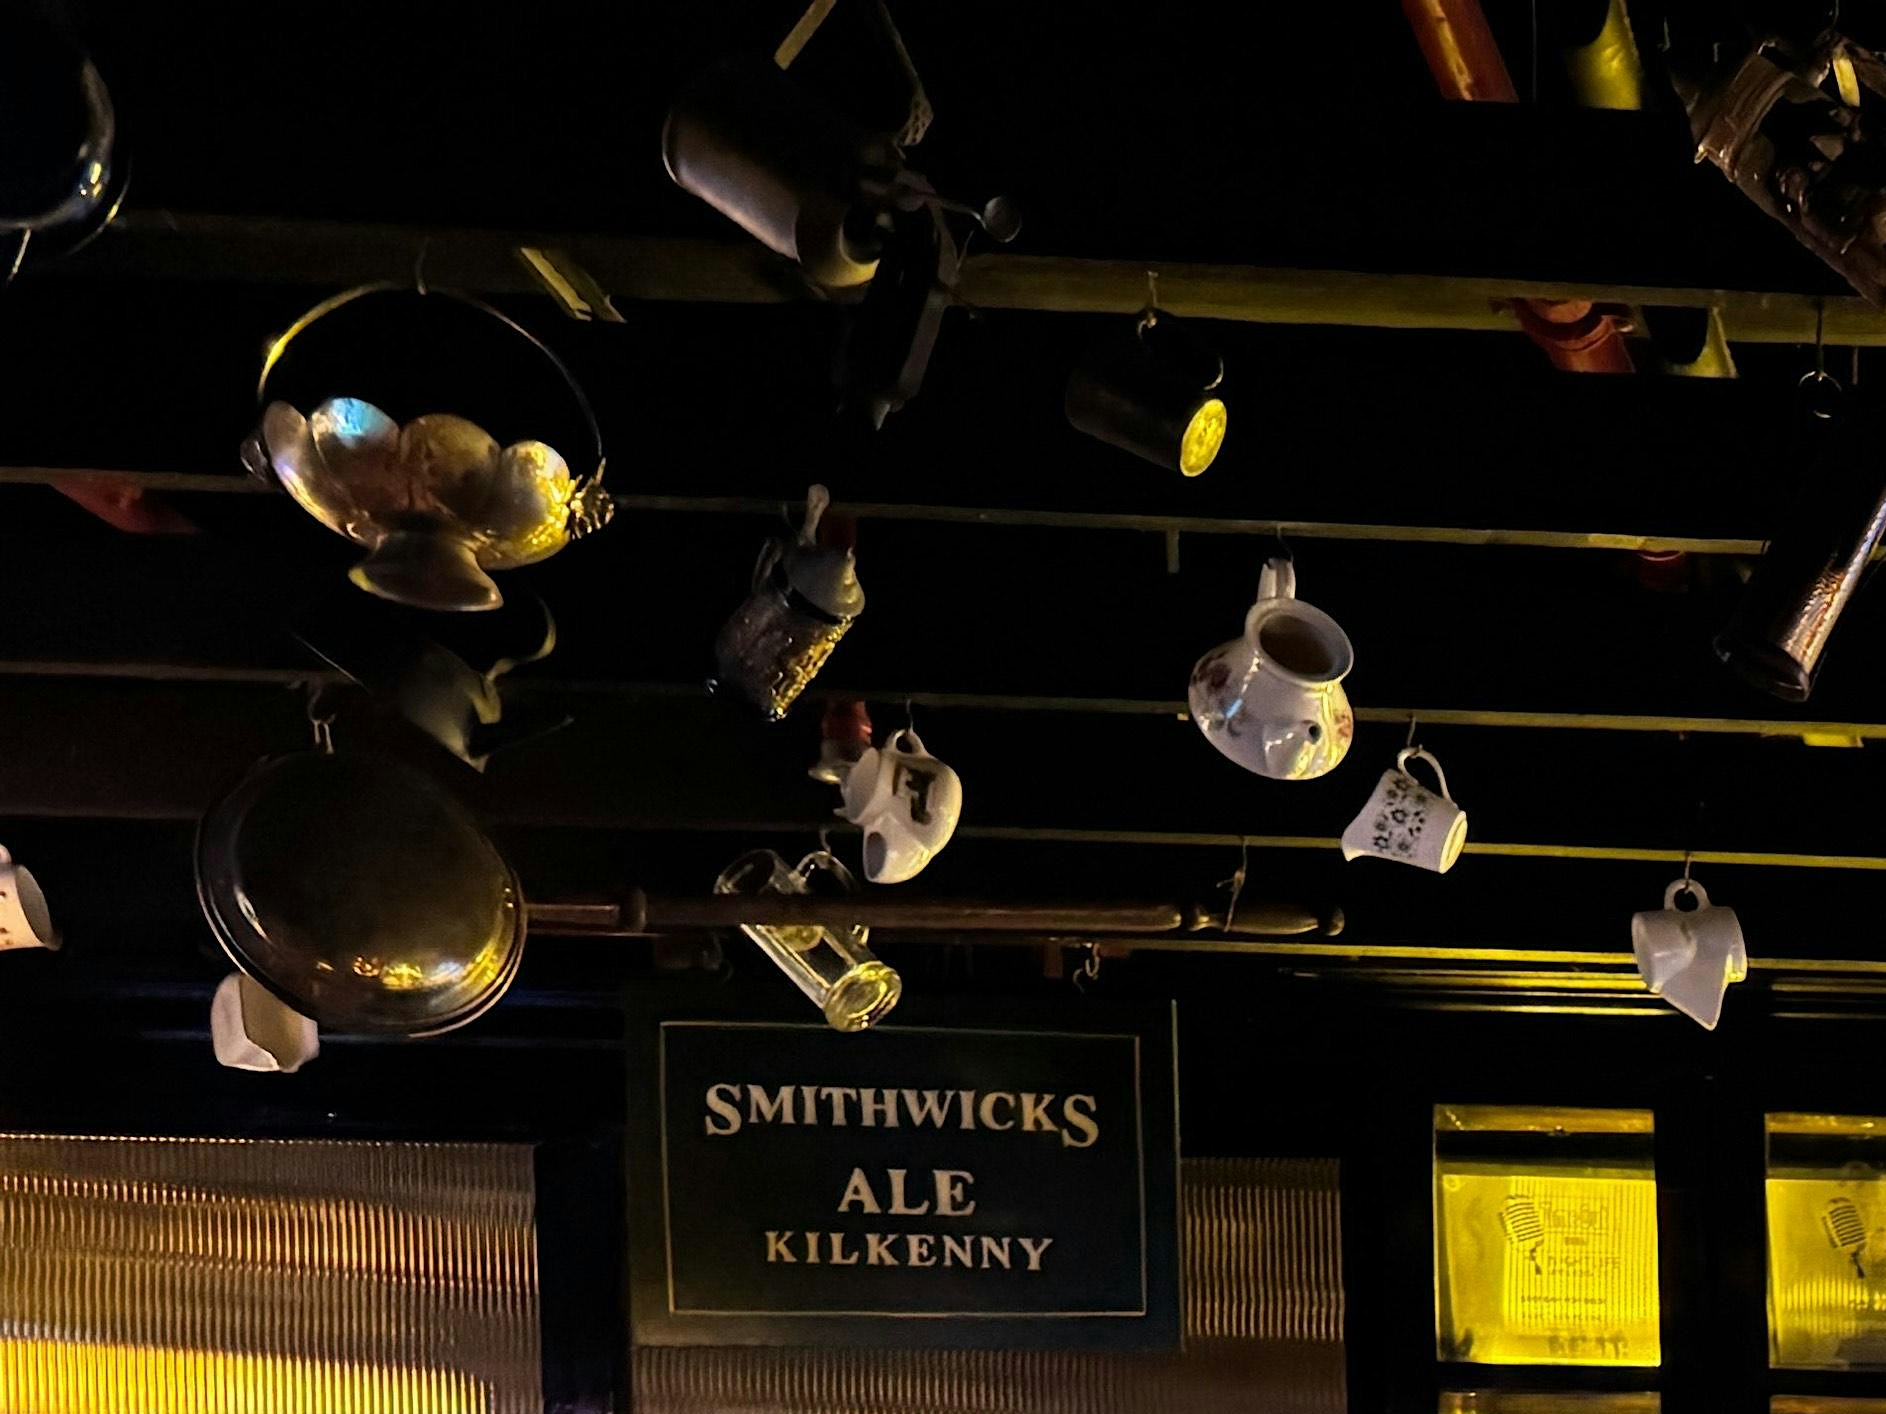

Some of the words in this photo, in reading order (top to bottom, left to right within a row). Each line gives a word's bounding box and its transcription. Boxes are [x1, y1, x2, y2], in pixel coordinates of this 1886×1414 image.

[704, 1083, 1100, 1148] SMITHWICKS
[837, 1167, 976, 1216] ALE
[764, 1230, 1054, 1271] KILKENNY
